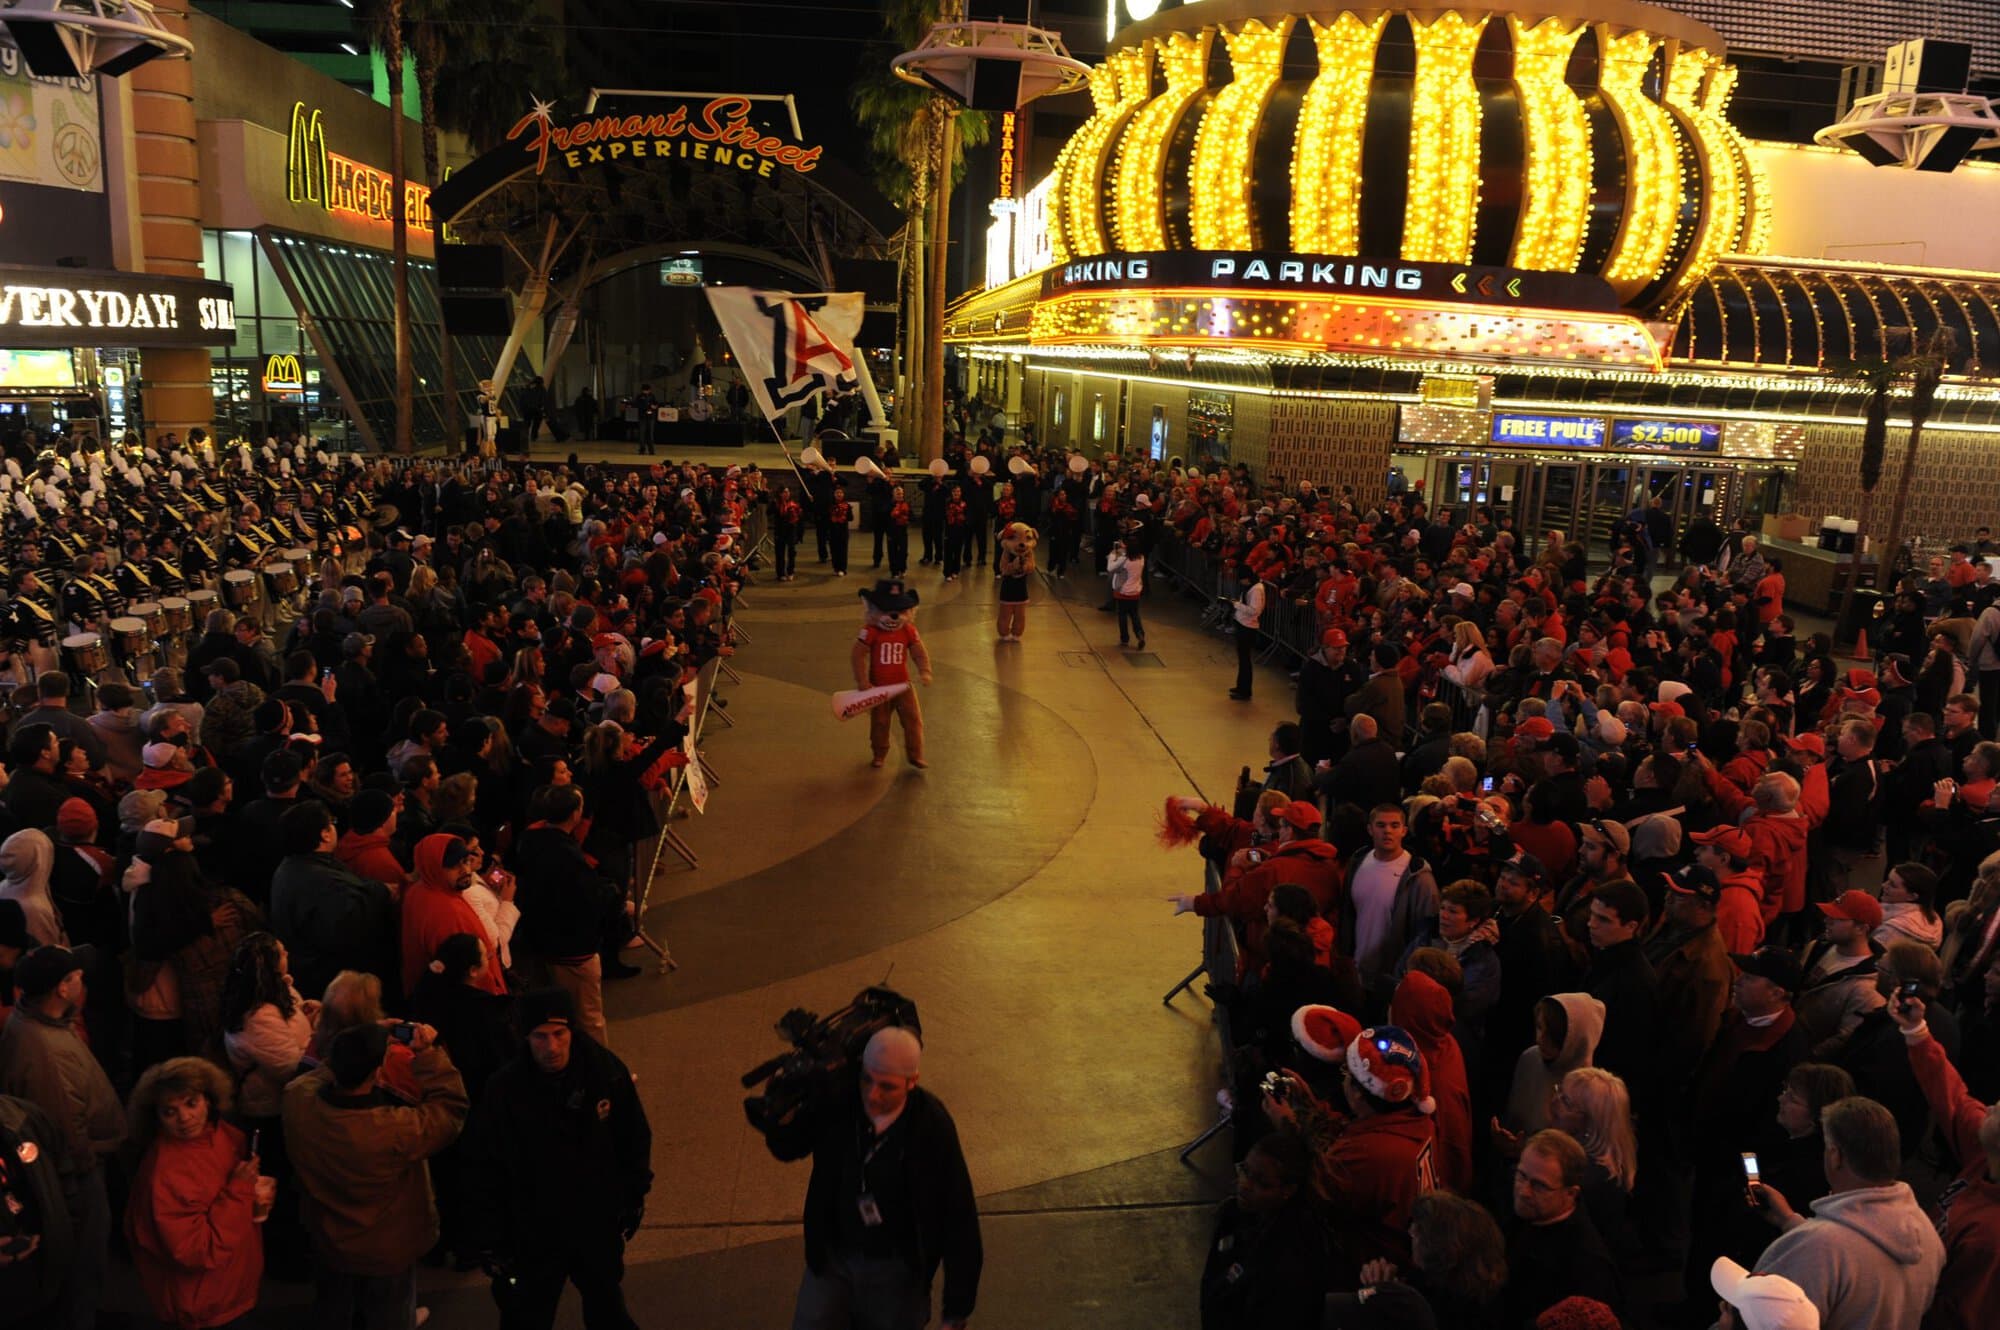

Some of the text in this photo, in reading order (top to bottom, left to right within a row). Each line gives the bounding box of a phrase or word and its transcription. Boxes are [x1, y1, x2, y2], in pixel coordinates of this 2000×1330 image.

[506, 96, 822, 175] Fremont Street
[565, 140, 775, 178] EXPERIENCE
[1000, 112, 1016, 198] NTRANCE
[1211, 258, 1422, 290] PARKING
[1500, 419, 1597, 440] FREE PULL
[1631, 425, 1701, 444] $2,500
